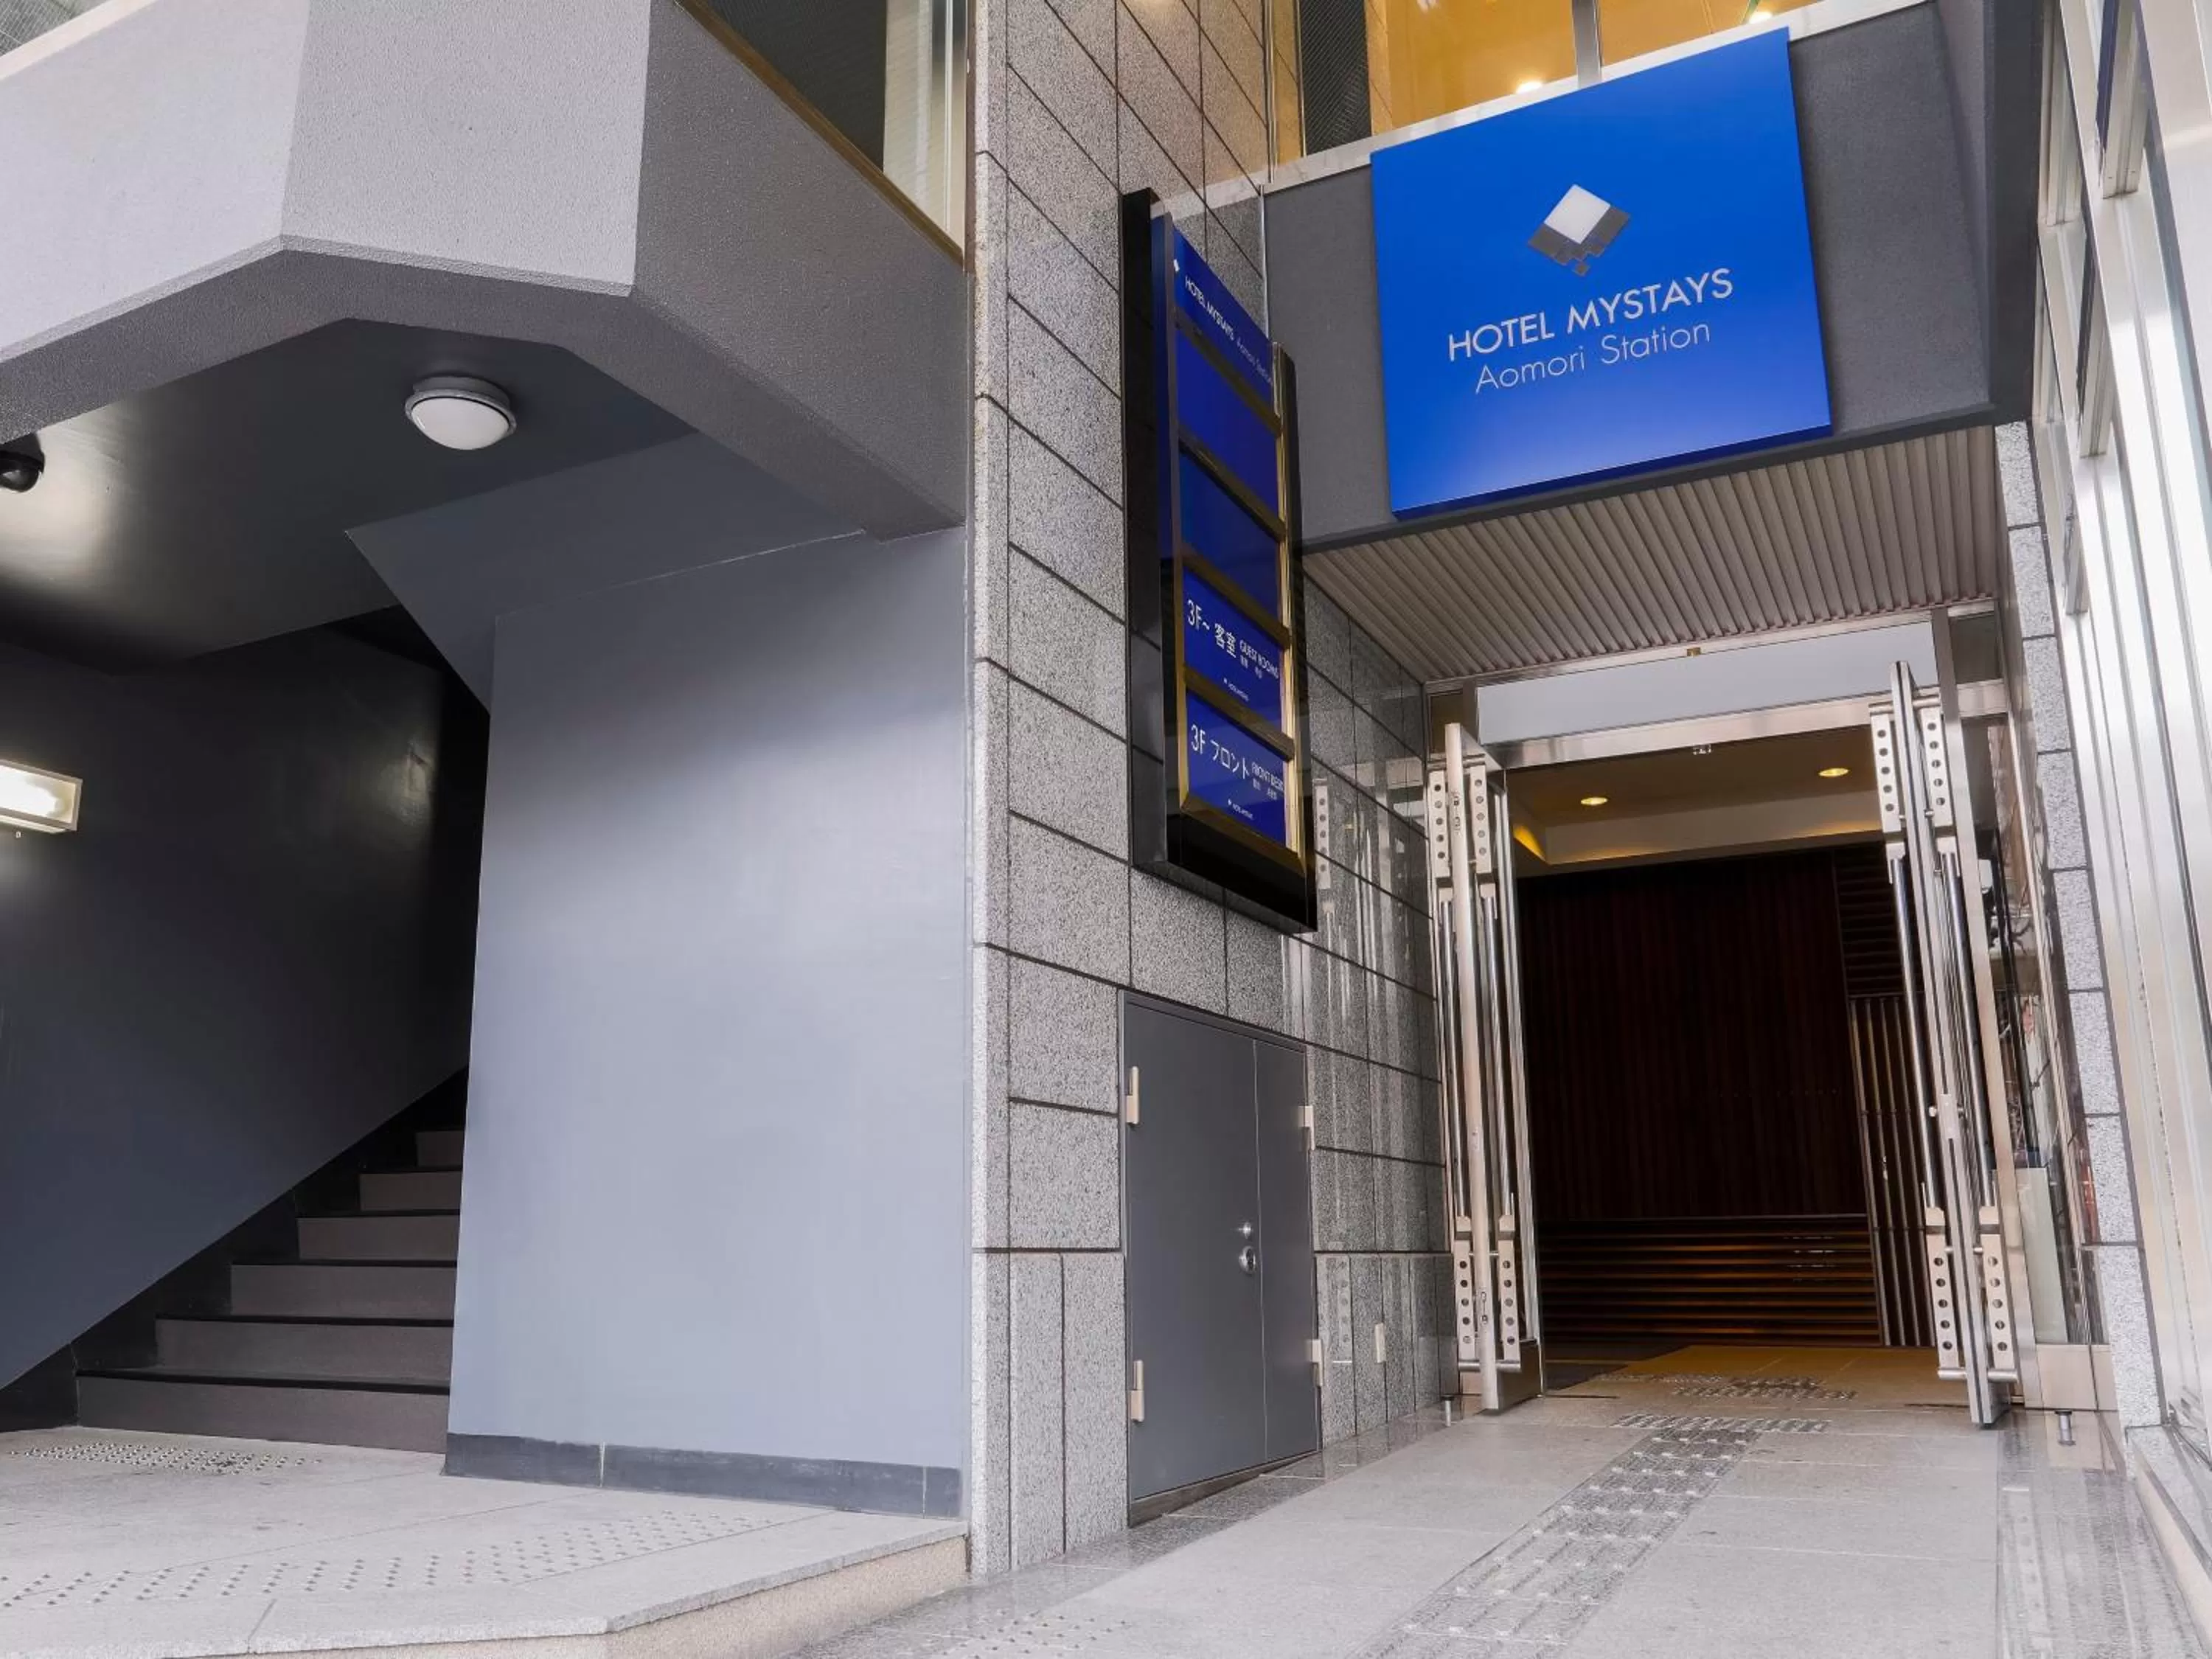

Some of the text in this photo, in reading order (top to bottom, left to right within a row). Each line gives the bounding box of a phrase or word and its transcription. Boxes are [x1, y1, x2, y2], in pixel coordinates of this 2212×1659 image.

[1186, 275, 1206, 309] HOTEL
[1448, 268, 1733, 362] HOTEL MYSTAYS
[1475, 323, 1711, 394] Aomori Station
[1215, 623, 1237, 658] 客室
[1191, 723, 1206, 755] 3F
[1210, 740, 1250, 780] フロント
